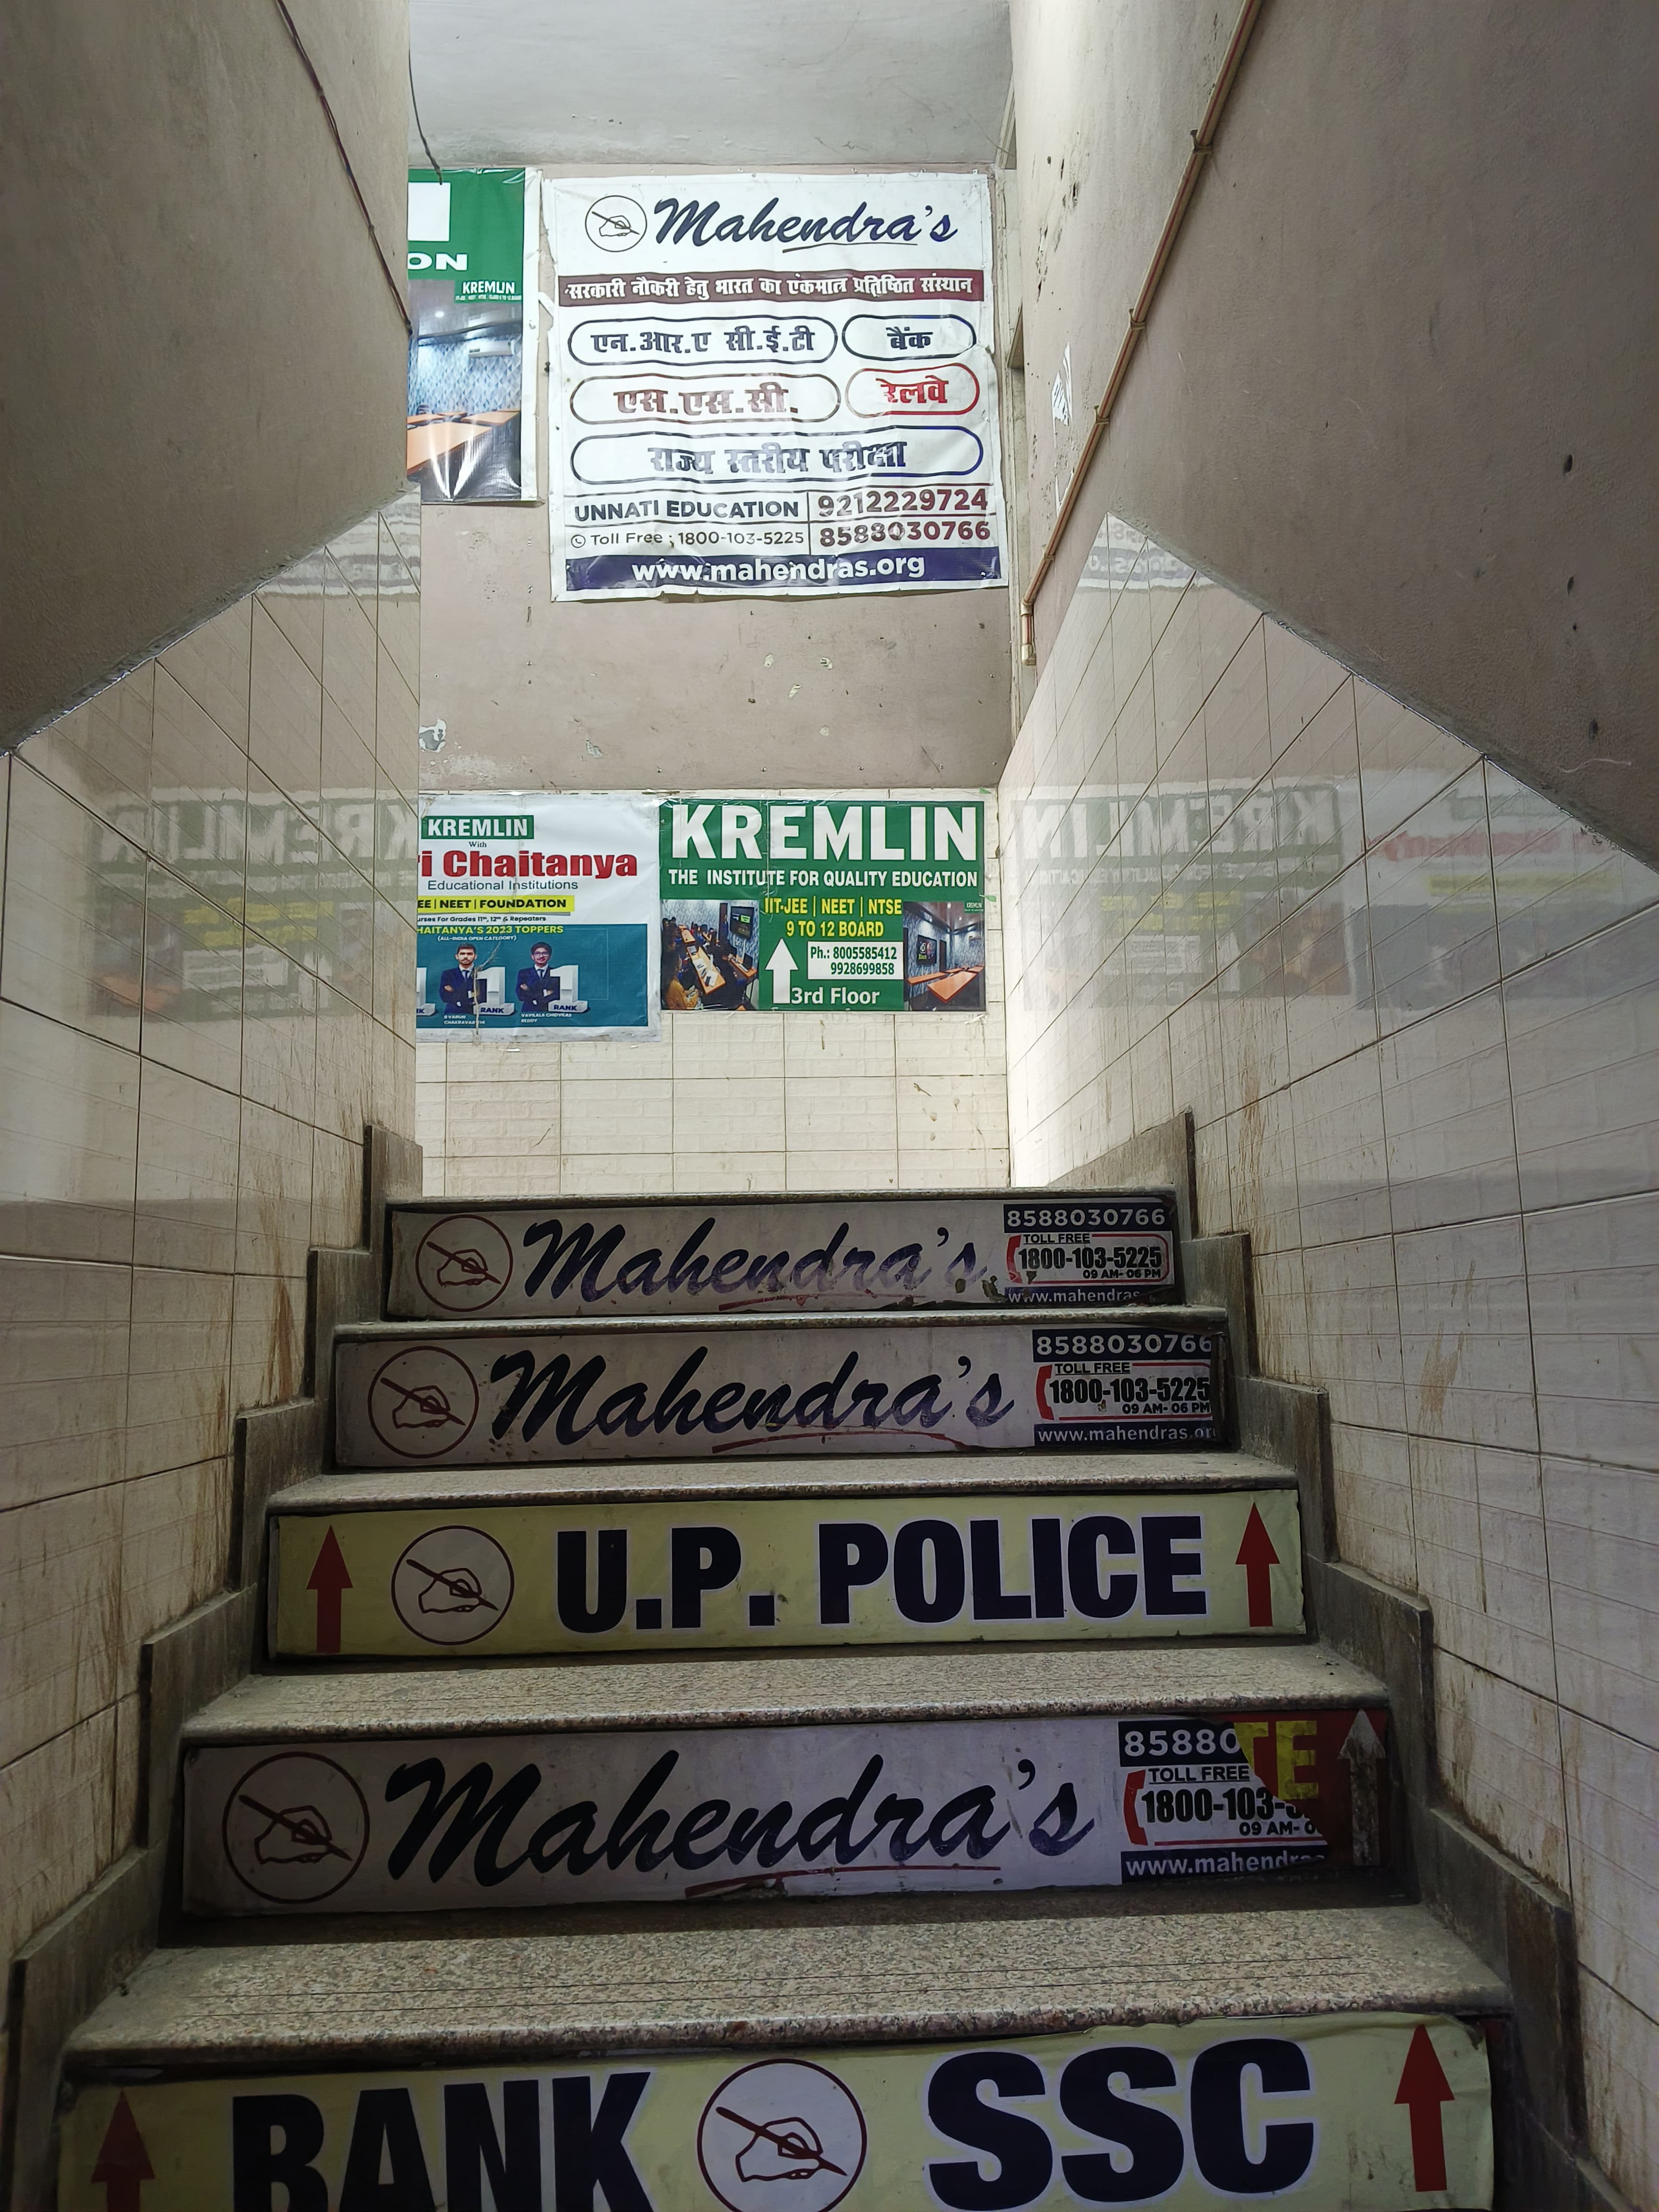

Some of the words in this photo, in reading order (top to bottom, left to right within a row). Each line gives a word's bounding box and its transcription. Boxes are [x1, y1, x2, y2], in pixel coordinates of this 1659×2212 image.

[654, 197, 957, 247] Mahendra's
[462, 281, 515, 294] KREMLIN
[567, 278, 627, 300] सरकारी
[630, 276, 681, 297] नौकरी
[684, 276, 710, 300] हेतु
[715, 277, 754, 295] भारत
[759, 277, 781, 295] का
[919, 273, 973, 293] संस्थान
[723, 325, 815, 352] सी.ई.टी
[886, 326, 933, 349] बैंक
[876, 375, 949, 403] रेलवे
[648, 447, 715, 474] राज्य
[724, 442, 810, 473] स्तरीय
[819, 440, 907, 472] परीक्षा
[575, 500, 659, 522] UNNATI
[666, 501, 798, 518] EDUCATION
[818, 488, 988, 517] 9212229724
[591, 532, 619, 546] Toll
[626, 532, 663, 544] Free
[678, 531, 804, 545] 1800-103-5225
[820, 521, 990, 547] 8588030766
[631, 555, 925, 581] www.mahendras.org
[428, 818, 528, 837] KREMLIN
[672, 805, 976, 861] KREMLIN
[418, 851, 432, 877] i
[443, 851, 637, 878] Chaitanya
[428, 880, 504, 890] Educational
[509, 880, 578, 890] Institutions
[668, 869, 698, 885] THE
[707, 869, 785, 886] INSTITUTE
[790, 870, 818, 886] FOR
[823, 871, 887, 888] QUALITY
[892, 871, 977, 888] EDUCATION
[440, 900, 471, 908] NEET
[480, 899, 566, 908] FOUNDATION
[765, 897, 808, 914] IIT-JEE
[822, 898, 855, 915] NEET
[868, 899, 902, 915] NTSE
[486, 926, 512, 934] 2023
[515, 926, 563, 934] TOPPERS
[787, 921, 794, 937] 9
[798, 921, 817, 938] TO
[820, 921, 834, 938] 12
[839, 921, 884, 938] BOARD
[833, 946, 897, 960] 8005585412
[830, 962, 894, 976] 9928699858
[791, 987, 827, 1004] 3rd
[831, 987, 879, 1005] Floor
[1007, 1208, 1166, 1227] 8588030766
[1023, 1234, 1055, 1244] TOLL
[1058, 1233, 1090, 1243] FREE
[523, 1217, 988, 1302] Mahendra's
[1018, 1246, 1162, 1270] 1800-103-5225
[1083, 1270, 1098, 1279] 09
[1125, 1270, 1142, 1279] 06
[1144, 1269, 1161, 1278] PM
[1036, 1334, 1212, 1355] 8588030766
[1055, 1363, 1091, 1373] TOLL
[1094, 1362, 1130, 1373] FREE
[490, 1346, 1014, 1446] Mahendra's
[1049, 1377, 1210, 1404] 1800-103-5225
[1122, 1404, 1140, 1414] 09
[1171, 1403, 1189, 1413] 06
[1192, 1402, 1210, 1413] PM
[557, 1527, 776, 1635] U.P.
[819, 1515, 1207, 1624] POLICE
[1149, 1767, 1199, 1782] TOLL
[1201, 1766, 1250, 1780] FREE
[385, 1750, 1094, 1887] Mahendra's
[1239, 1822, 1260, 1836] 09
[1304, 1821, 1322, 1834] 0
[231, 2071, 654, 2212] BANK
[924, 2038, 1316, 2211] SSC
